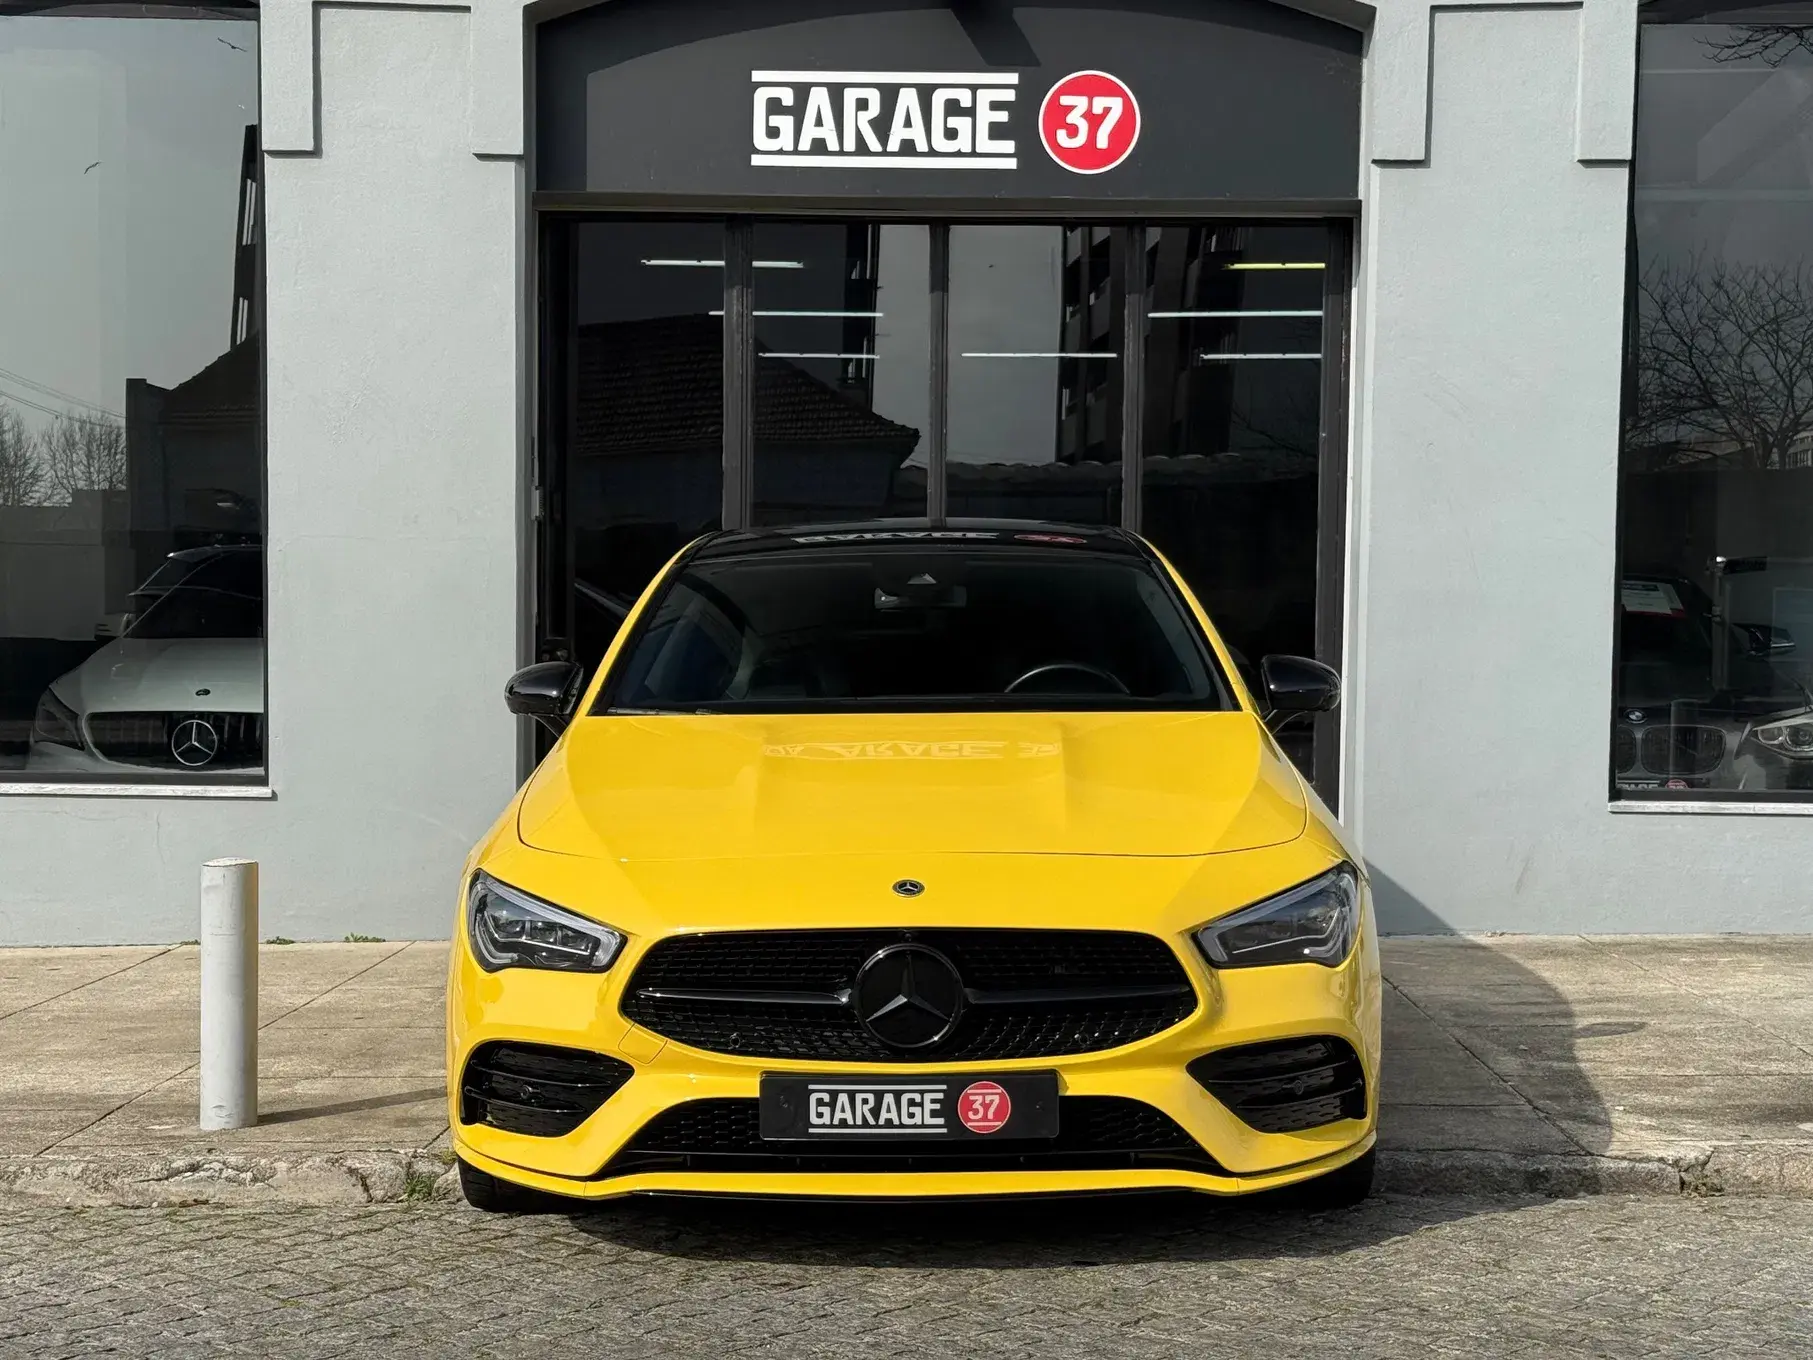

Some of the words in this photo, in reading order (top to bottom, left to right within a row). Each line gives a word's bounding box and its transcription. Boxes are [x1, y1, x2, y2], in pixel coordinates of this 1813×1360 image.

[752, 86, 1016, 153] GARAGE
[1055, 95, 1123, 149] 37
[809, 1092, 945, 1126] GARAGE
[967, 1094, 1000, 1120] 37
